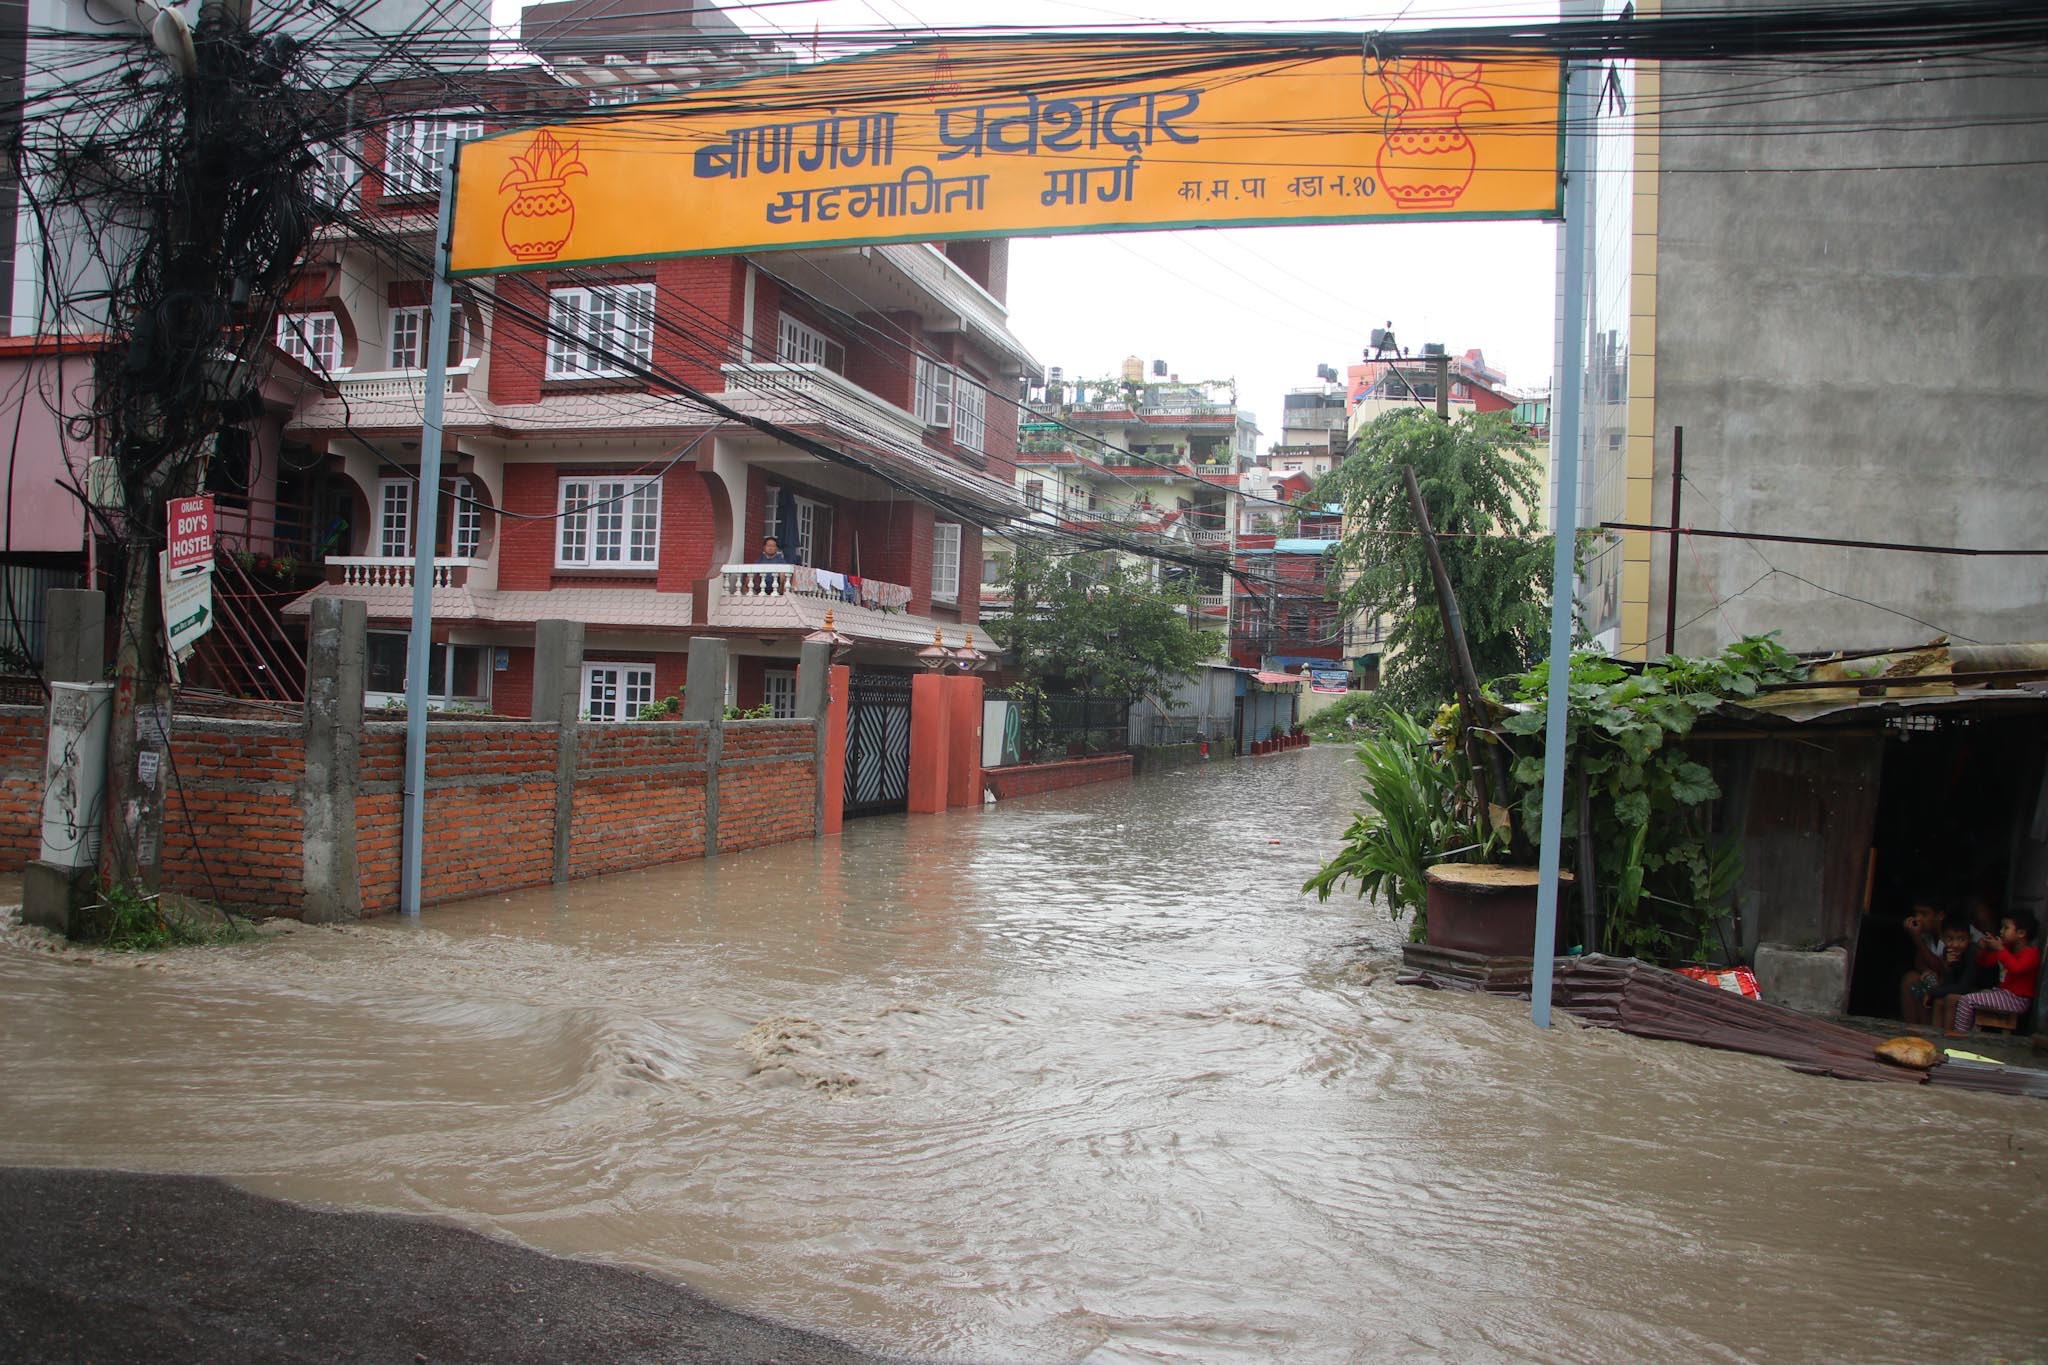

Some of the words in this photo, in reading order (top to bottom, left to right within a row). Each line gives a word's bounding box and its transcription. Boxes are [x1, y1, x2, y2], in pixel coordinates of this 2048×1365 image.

[693, 107, 900, 180] बाणगंगा
[934, 88, 1206, 161] प्रवेशद्वार
[1041, 155, 1143, 206] मार्ग
[1287, 176, 1324, 198] वडा
[181, 500, 203, 514] ORACLE
[177, 514, 208, 536] BOY'S
[172, 535, 213, 558] HOSTEL
